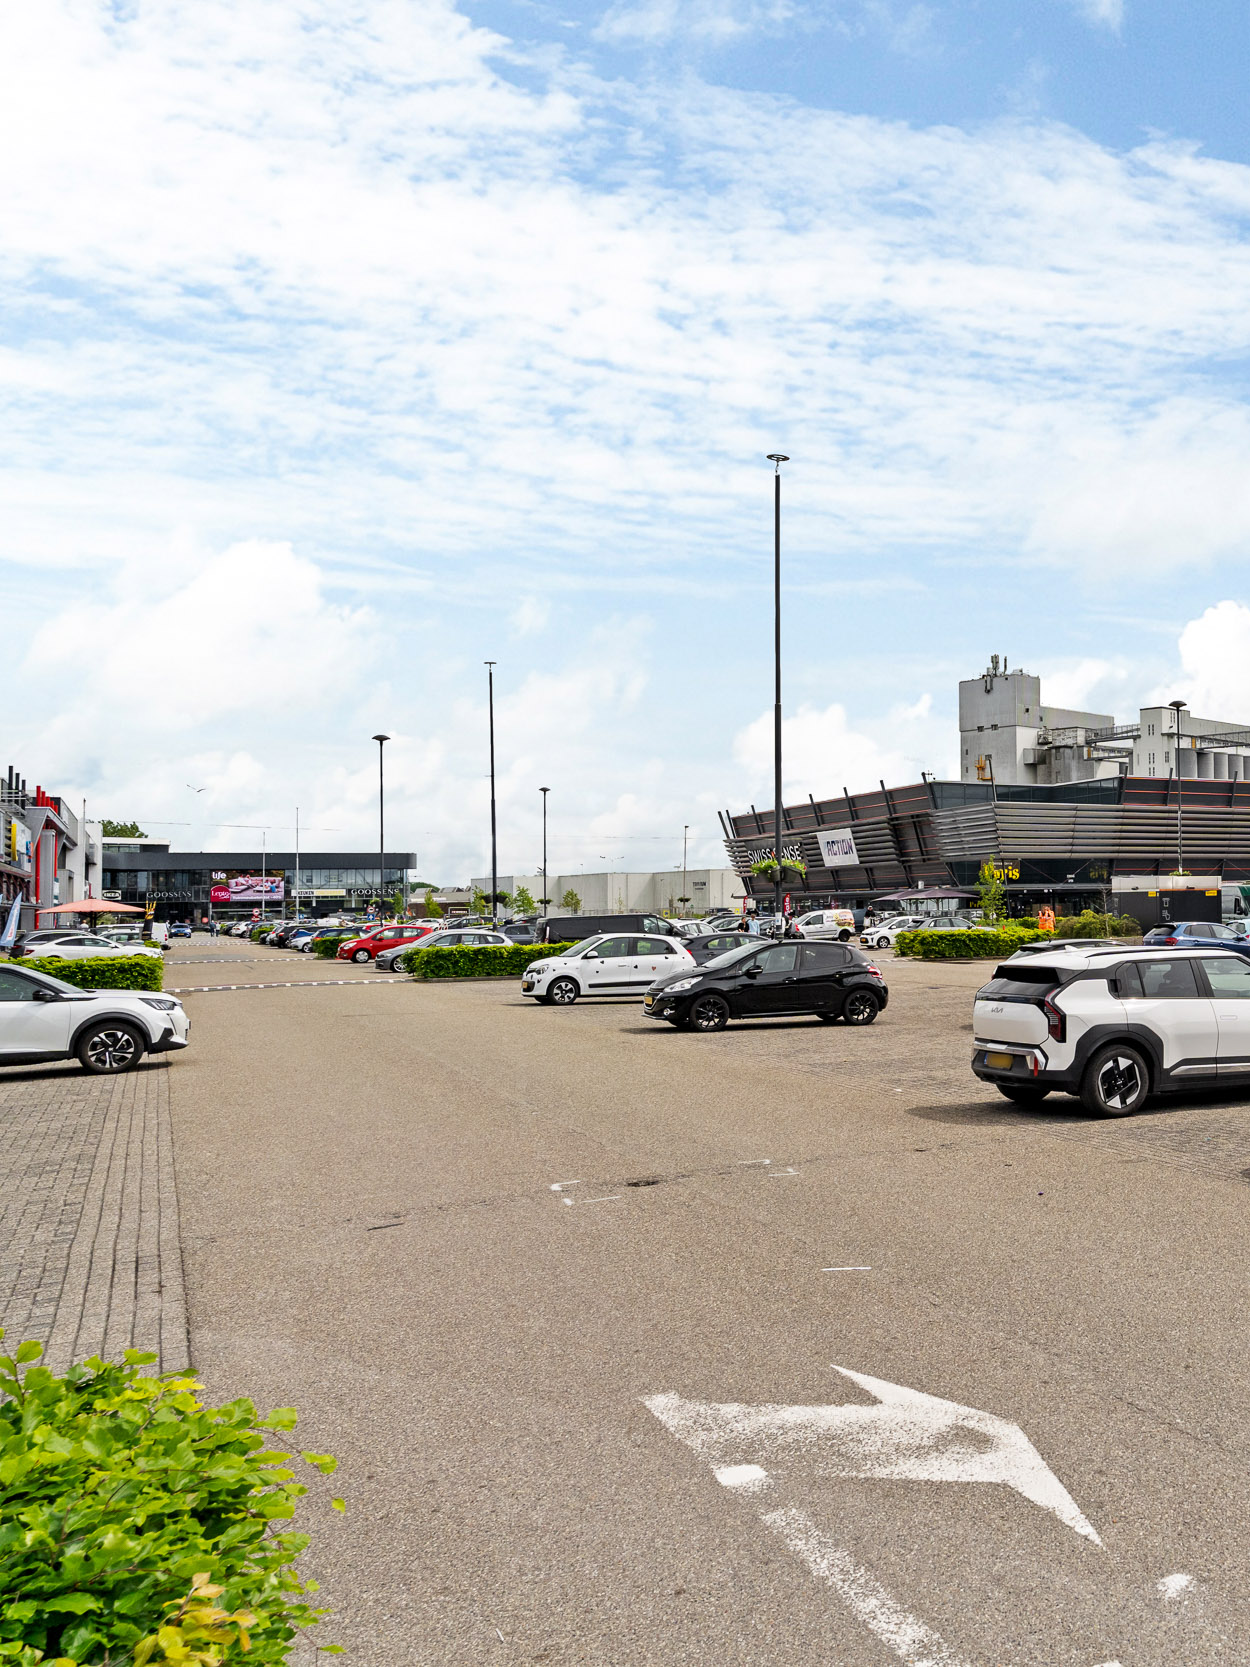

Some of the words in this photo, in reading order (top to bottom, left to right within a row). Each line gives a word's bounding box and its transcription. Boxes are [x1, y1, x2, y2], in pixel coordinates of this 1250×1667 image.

[826, 838, 854, 857] ACTION
[146, 891, 192, 899] GOOSSENS
[351, 888, 400, 896] GOOSSENS
